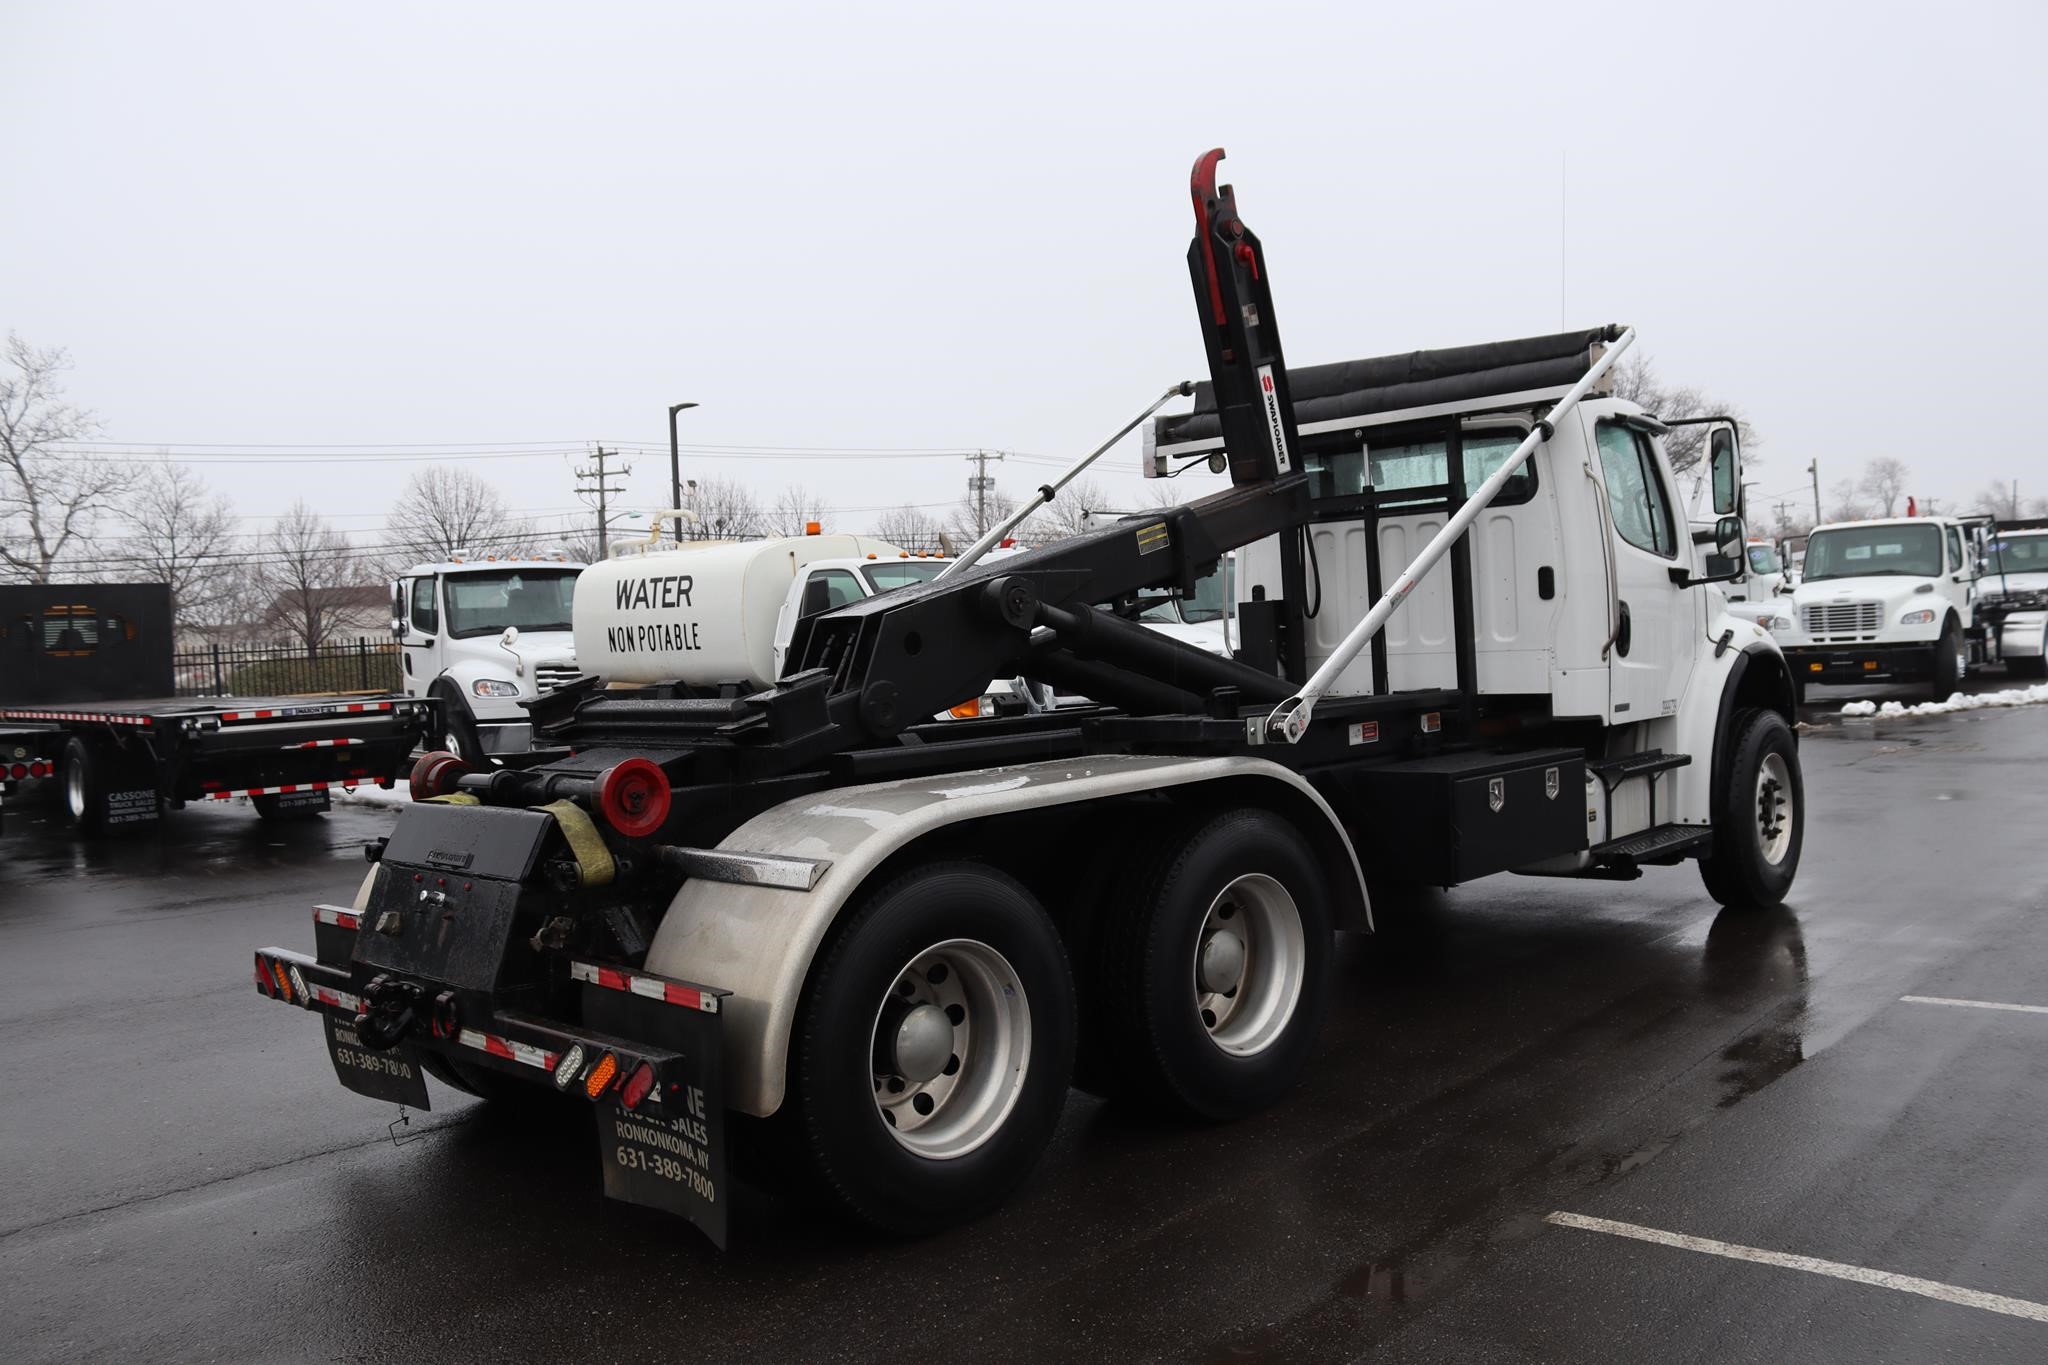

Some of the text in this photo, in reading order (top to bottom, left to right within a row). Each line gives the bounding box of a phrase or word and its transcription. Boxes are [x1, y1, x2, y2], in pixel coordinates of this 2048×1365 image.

[1267, 394, 1286, 465] SWAPLOADER
[616, 575, 693, 610] WATER
[608, 623, 701, 653] NON POTABLE
[108, 789, 155, 802] CASSONE
[616, 1121, 709, 1171] RONKONKOMA, NY
[617, 1146, 714, 1203] 631-389-7800
